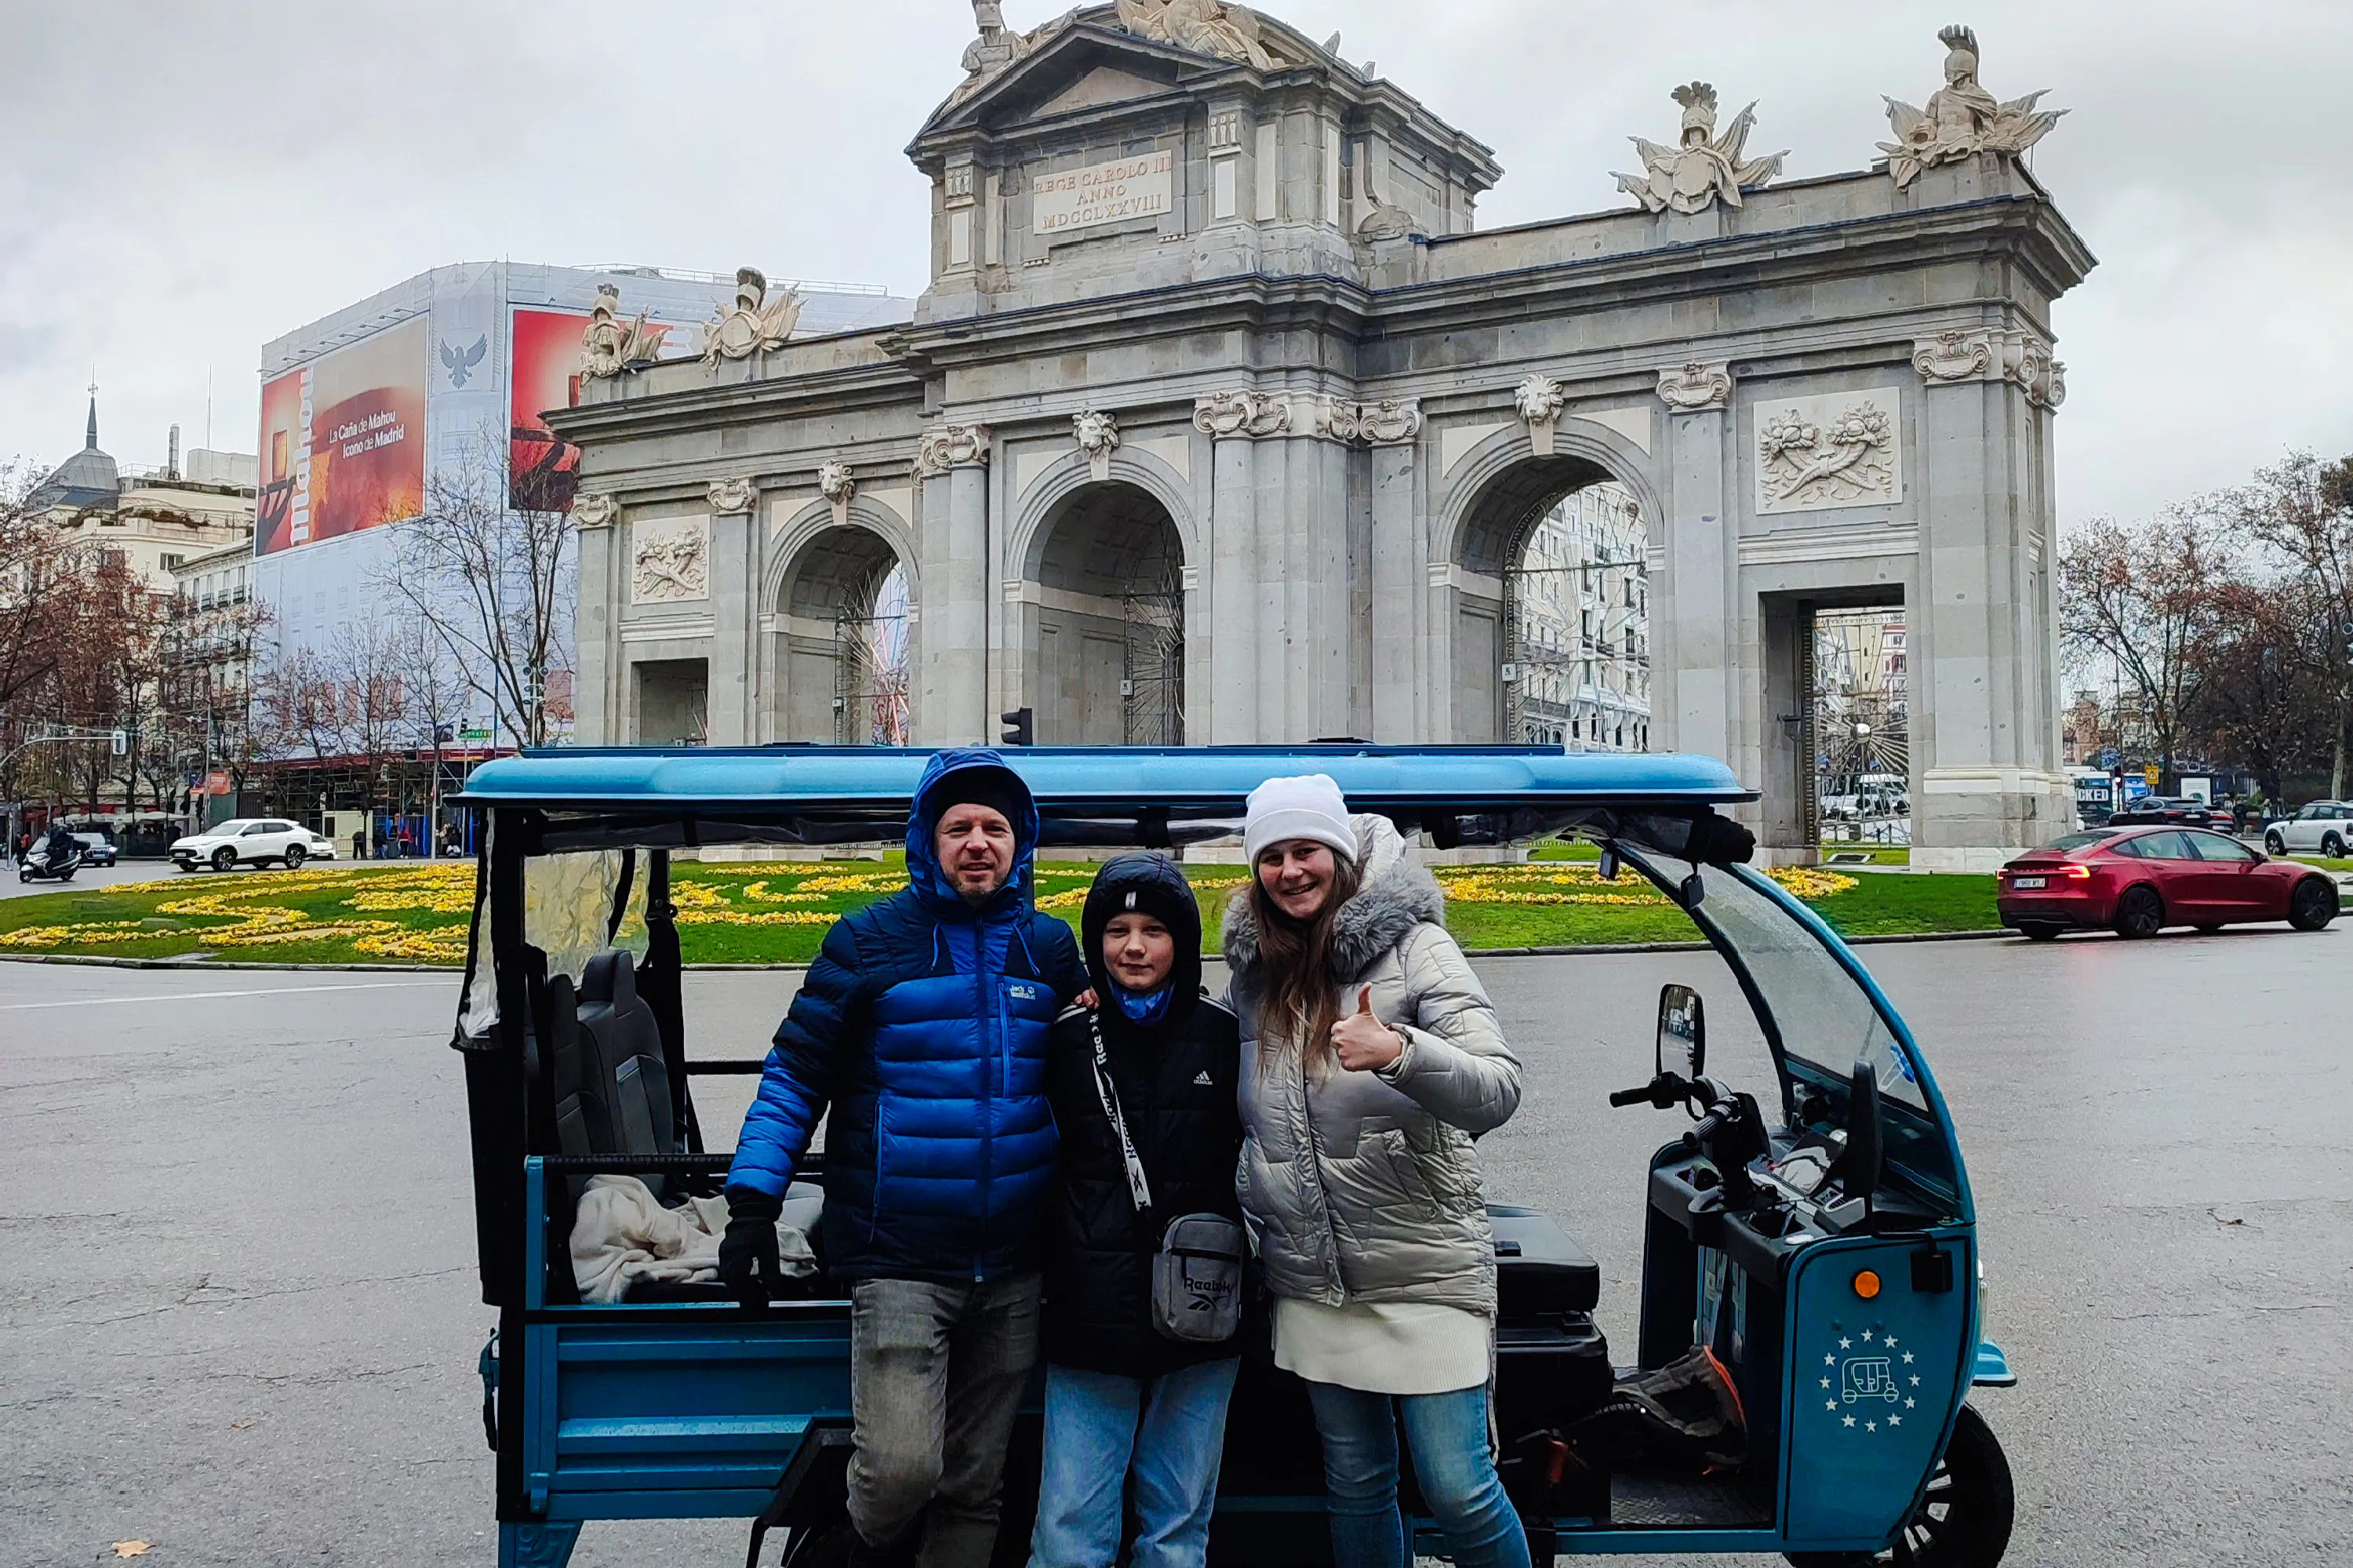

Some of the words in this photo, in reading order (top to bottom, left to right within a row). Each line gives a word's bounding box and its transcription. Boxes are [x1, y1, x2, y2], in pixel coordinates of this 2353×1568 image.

[1035, 176, 1076, 195] REGE
[1082, 162, 1147, 186] CAROLO
[1154, 156, 1172, 173] III
[1042, 194, 1162, 230] MDCCLXXVIII
[1077, 185, 1126, 206] ANNO
[329, 429, 338, 443] La
[339, 421, 358, 440] Caña
[358, 417, 368, 434] de
[368, 409, 396, 431] Mahou
[343, 441, 362, 460] Icono
[364, 435, 374, 451] de
[375, 423, 404, 448] Madrid
